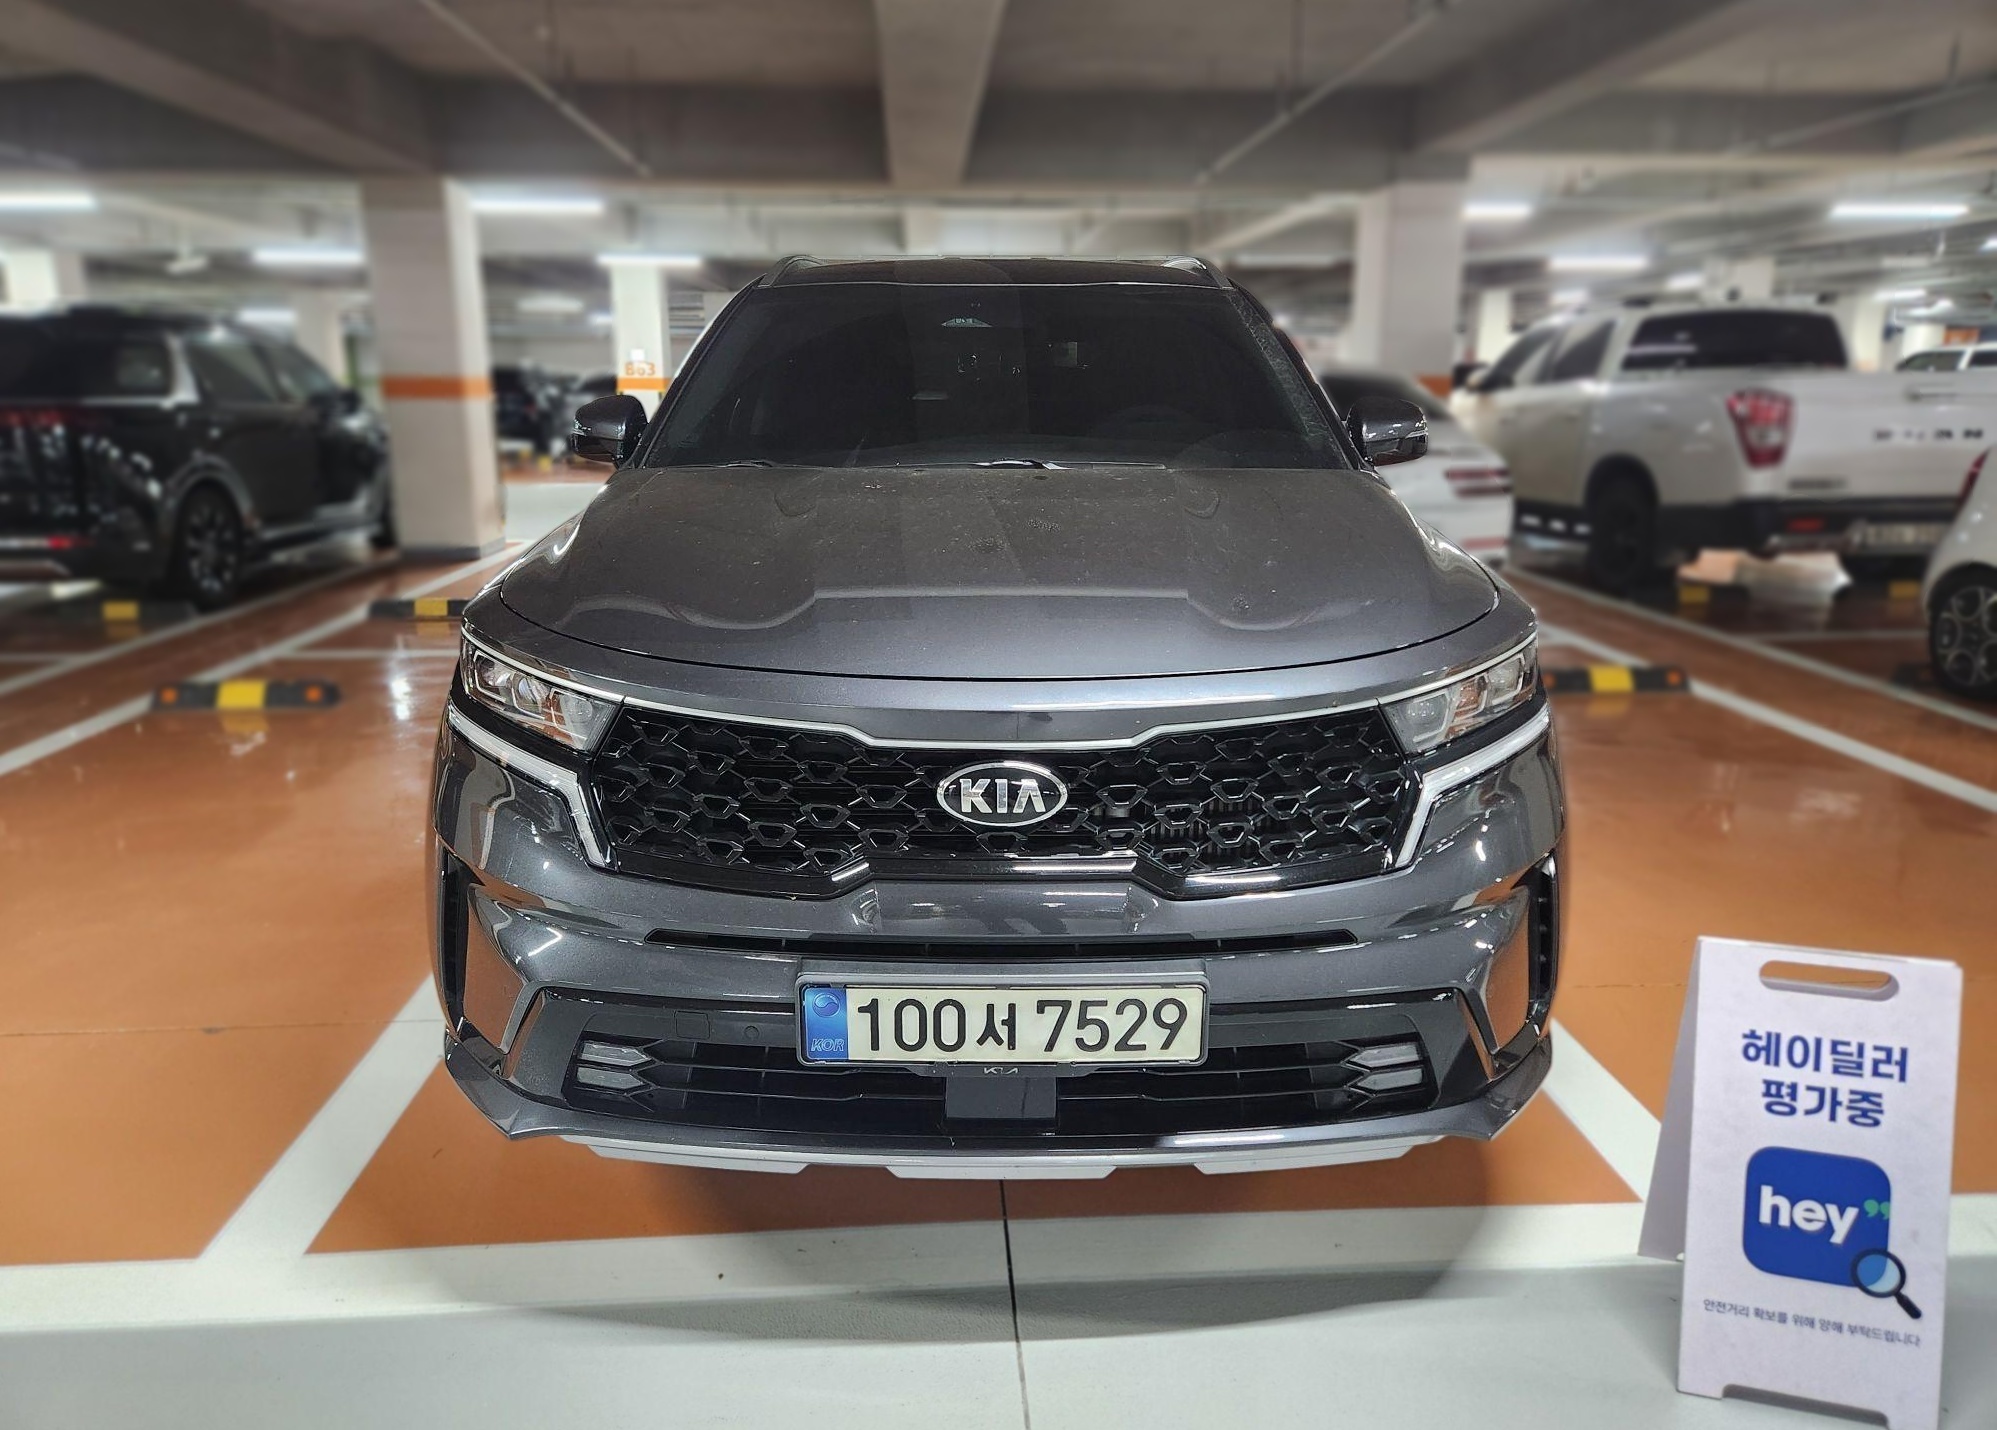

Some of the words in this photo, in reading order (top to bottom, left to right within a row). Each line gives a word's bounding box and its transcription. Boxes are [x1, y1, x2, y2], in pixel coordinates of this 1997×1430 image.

[959, 778, 1046, 813] KIA
[810, 1038, 845, 1052] KOR
[857, 998, 1016, 1052] 100서
[1037, 998, 1188, 1052] 7529
[1742, 1029, 1908, 1083] 헤이딜러
[1761, 1079, 1884, 1128] 평가중
[1758, 1185, 1860, 1245] hey
[1703, 1299, 1750, 1318] 안전거리
[1753, 1307, 1788, 1325] 확보를
[1792, 1314, 1815, 1329] 위해
[1818, 1319, 1843, 1335] 양해
[1847, 1324, 1921, 1347] 부탁드립니다
